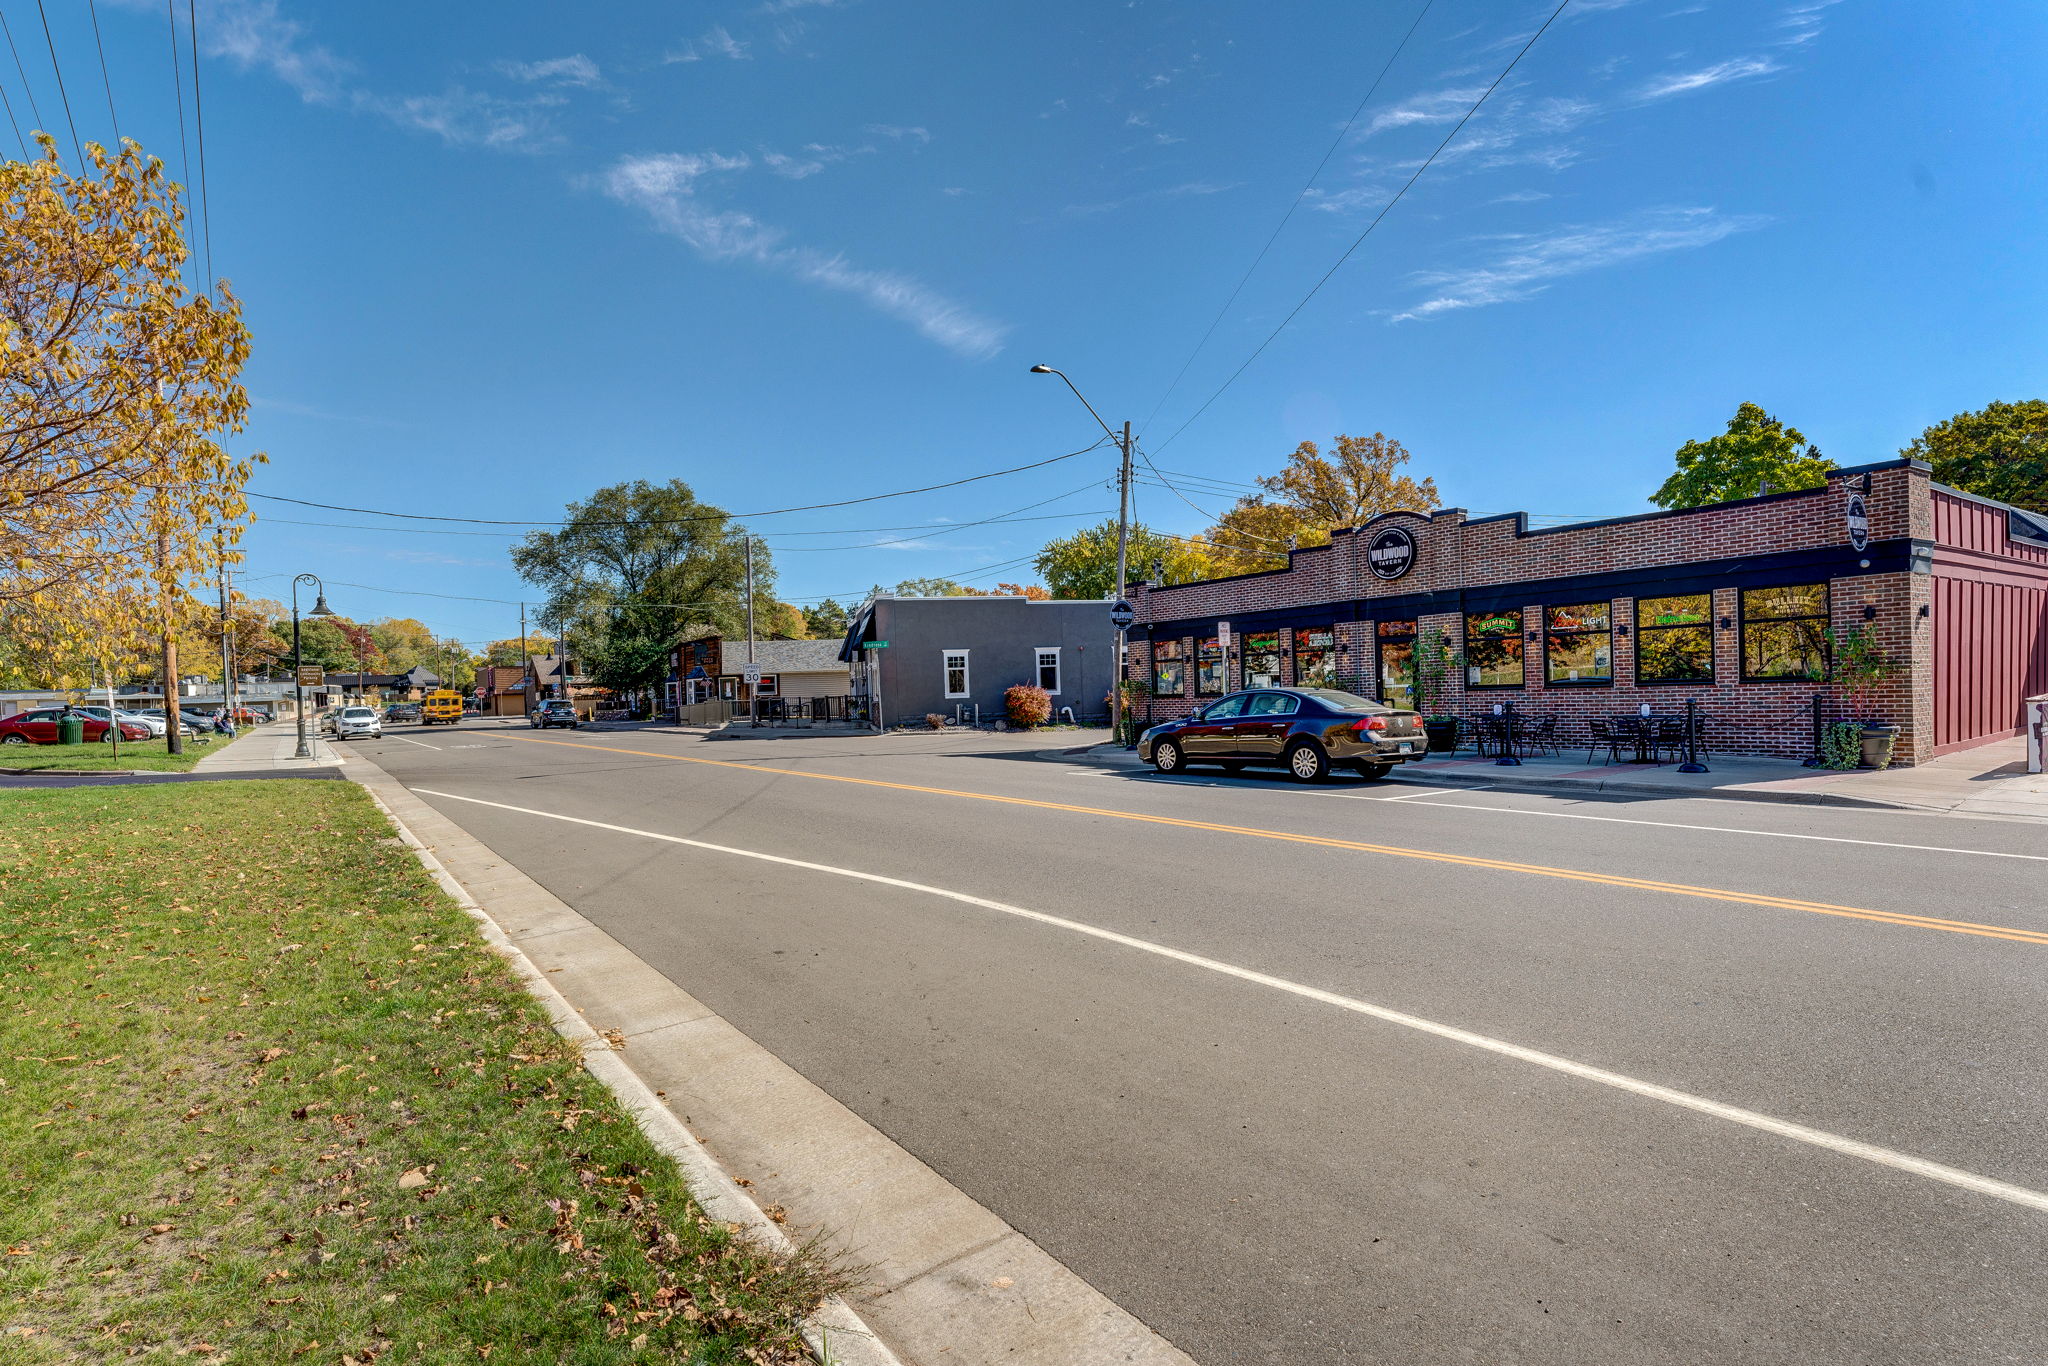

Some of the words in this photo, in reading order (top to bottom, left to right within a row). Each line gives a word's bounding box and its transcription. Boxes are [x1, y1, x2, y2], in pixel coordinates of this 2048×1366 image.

[1371, 545, 1409, 562] WILDWOOD
[1378, 559, 1402, 567] TAVERN
[1481, 618, 1514, 630] SUMMIT
[1581, 615, 1607, 625] LIGHT
[746, 673, 759, 681] 30
